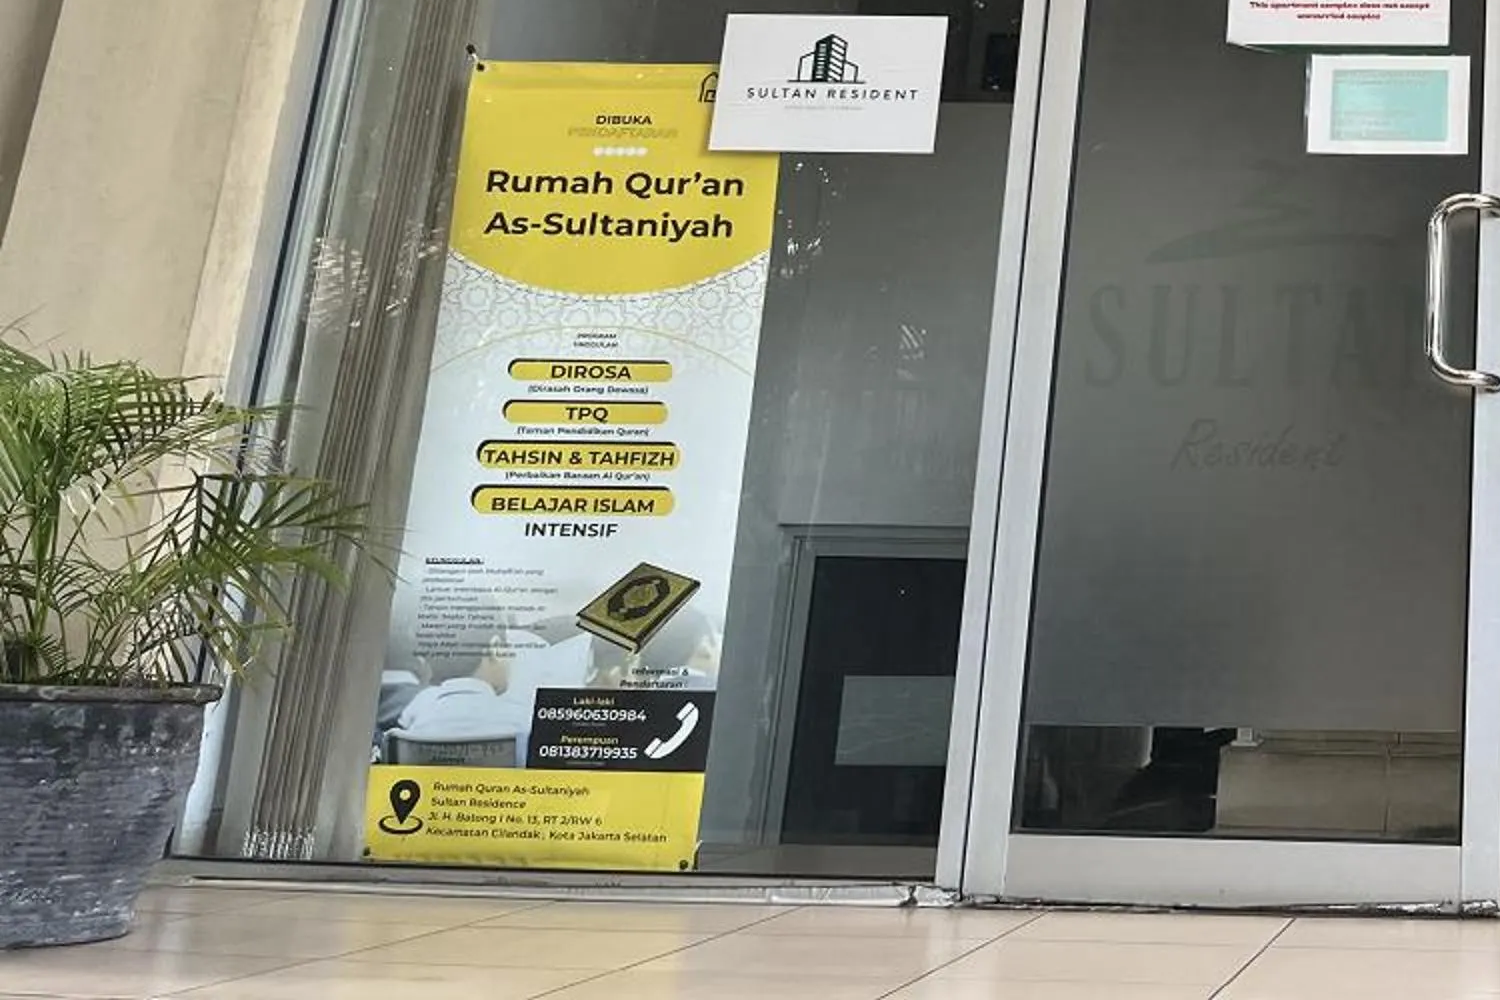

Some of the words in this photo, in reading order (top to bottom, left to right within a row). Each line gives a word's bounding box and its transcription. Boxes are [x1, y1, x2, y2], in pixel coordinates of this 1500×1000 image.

[747, 87, 817, 99] SULTAN
[827, 89, 919, 101] RESIDENT
[595, 114, 653, 125] DIBUKA
[486, 169, 613, 196] Rumah
[484, 210, 734, 242] As-Sultaniyah
[551, 365, 632, 380] DIROSA
[566, 407, 609, 424] TPQ
[484, 449, 562, 464] TAHSIN
[568, 452, 582, 465] &
[589, 451, 674, 466] TAHFIZH
[491, 496, 586, 512] BELAJAR
[593, 499, 654, 513] ISLAM
[524, 522, 618, 538] INTENSIF
[538, 707, 647, 722] 085960630984
[561, 736, 618, 746] Perempuan
[539, 746, 638, 760] 081383719935
[433, 782, 473, 794] Rumah
[476, 783, 510, 795] Quran
[513, 785, 590, 797] As-Sultaniyah
[431, 798, 466, 808] Sultan
[469, 798, 526, 809] Residence
[544, 816, 557, 825] RT
[425, 828, 489, 839] Kecamatan
[549, 832, 575, 842] Kota
[578, 832, 621, 842] Jakarta
[624, 832, 668, 844] Selatan
